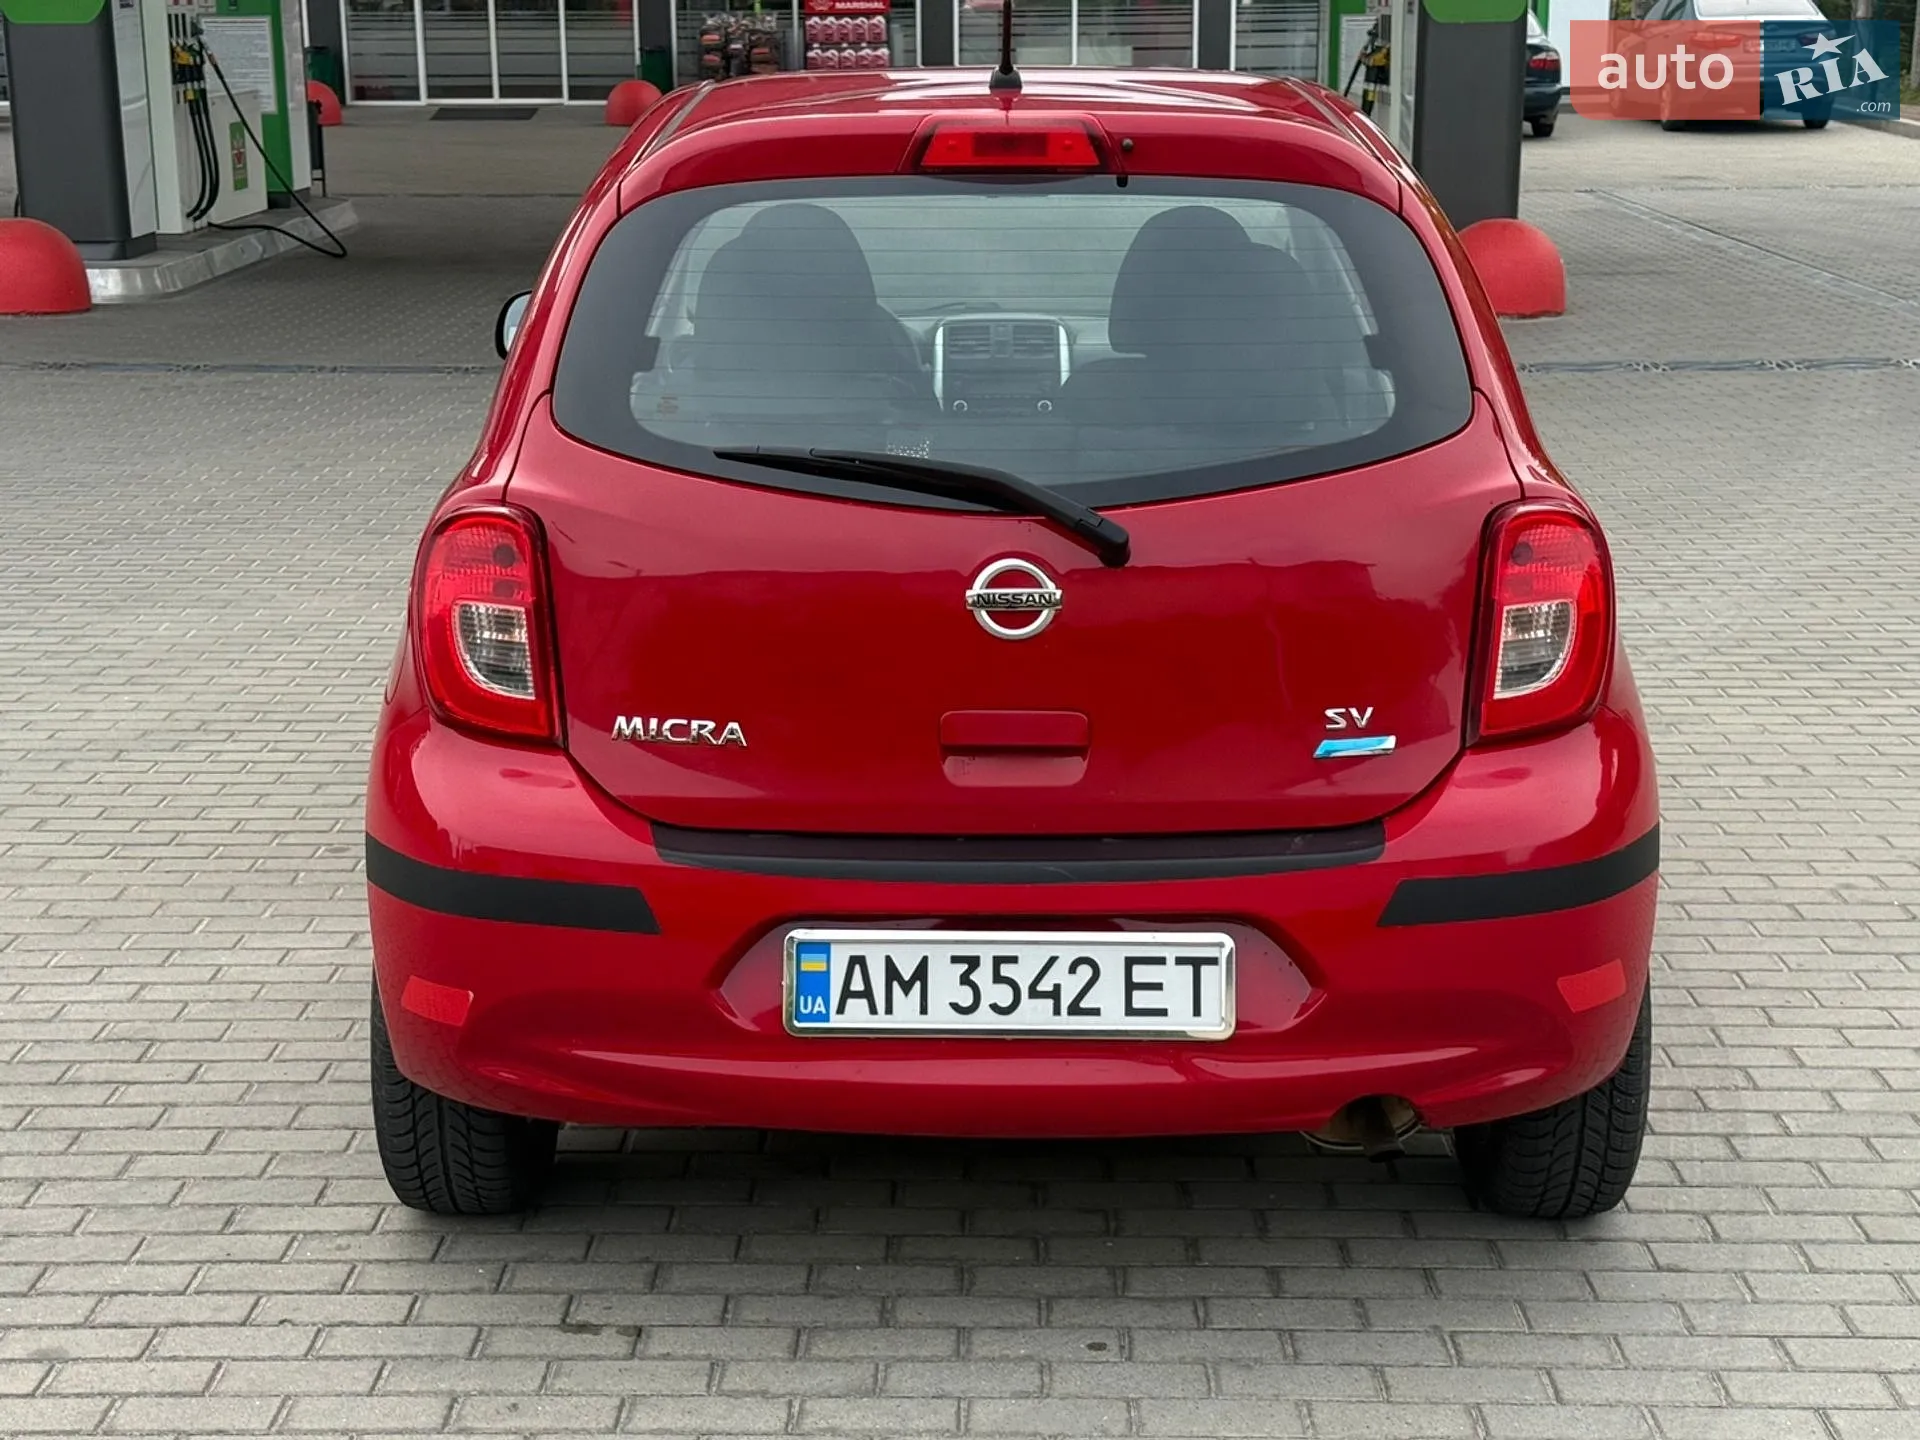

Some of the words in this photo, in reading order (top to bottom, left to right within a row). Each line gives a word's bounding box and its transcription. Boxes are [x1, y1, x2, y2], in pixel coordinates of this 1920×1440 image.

[976, 592, 1053, 605] NISSAN
[1324, 706, 1374, 729] SV
[611, 715, 747, 746] MICRA
[836, 954, 929, 1016] AM
[948, 955, 1102, 1017] 3542
[1124, 956, 1219, 1018] ET
[800, 995, 826, 1014] UA
